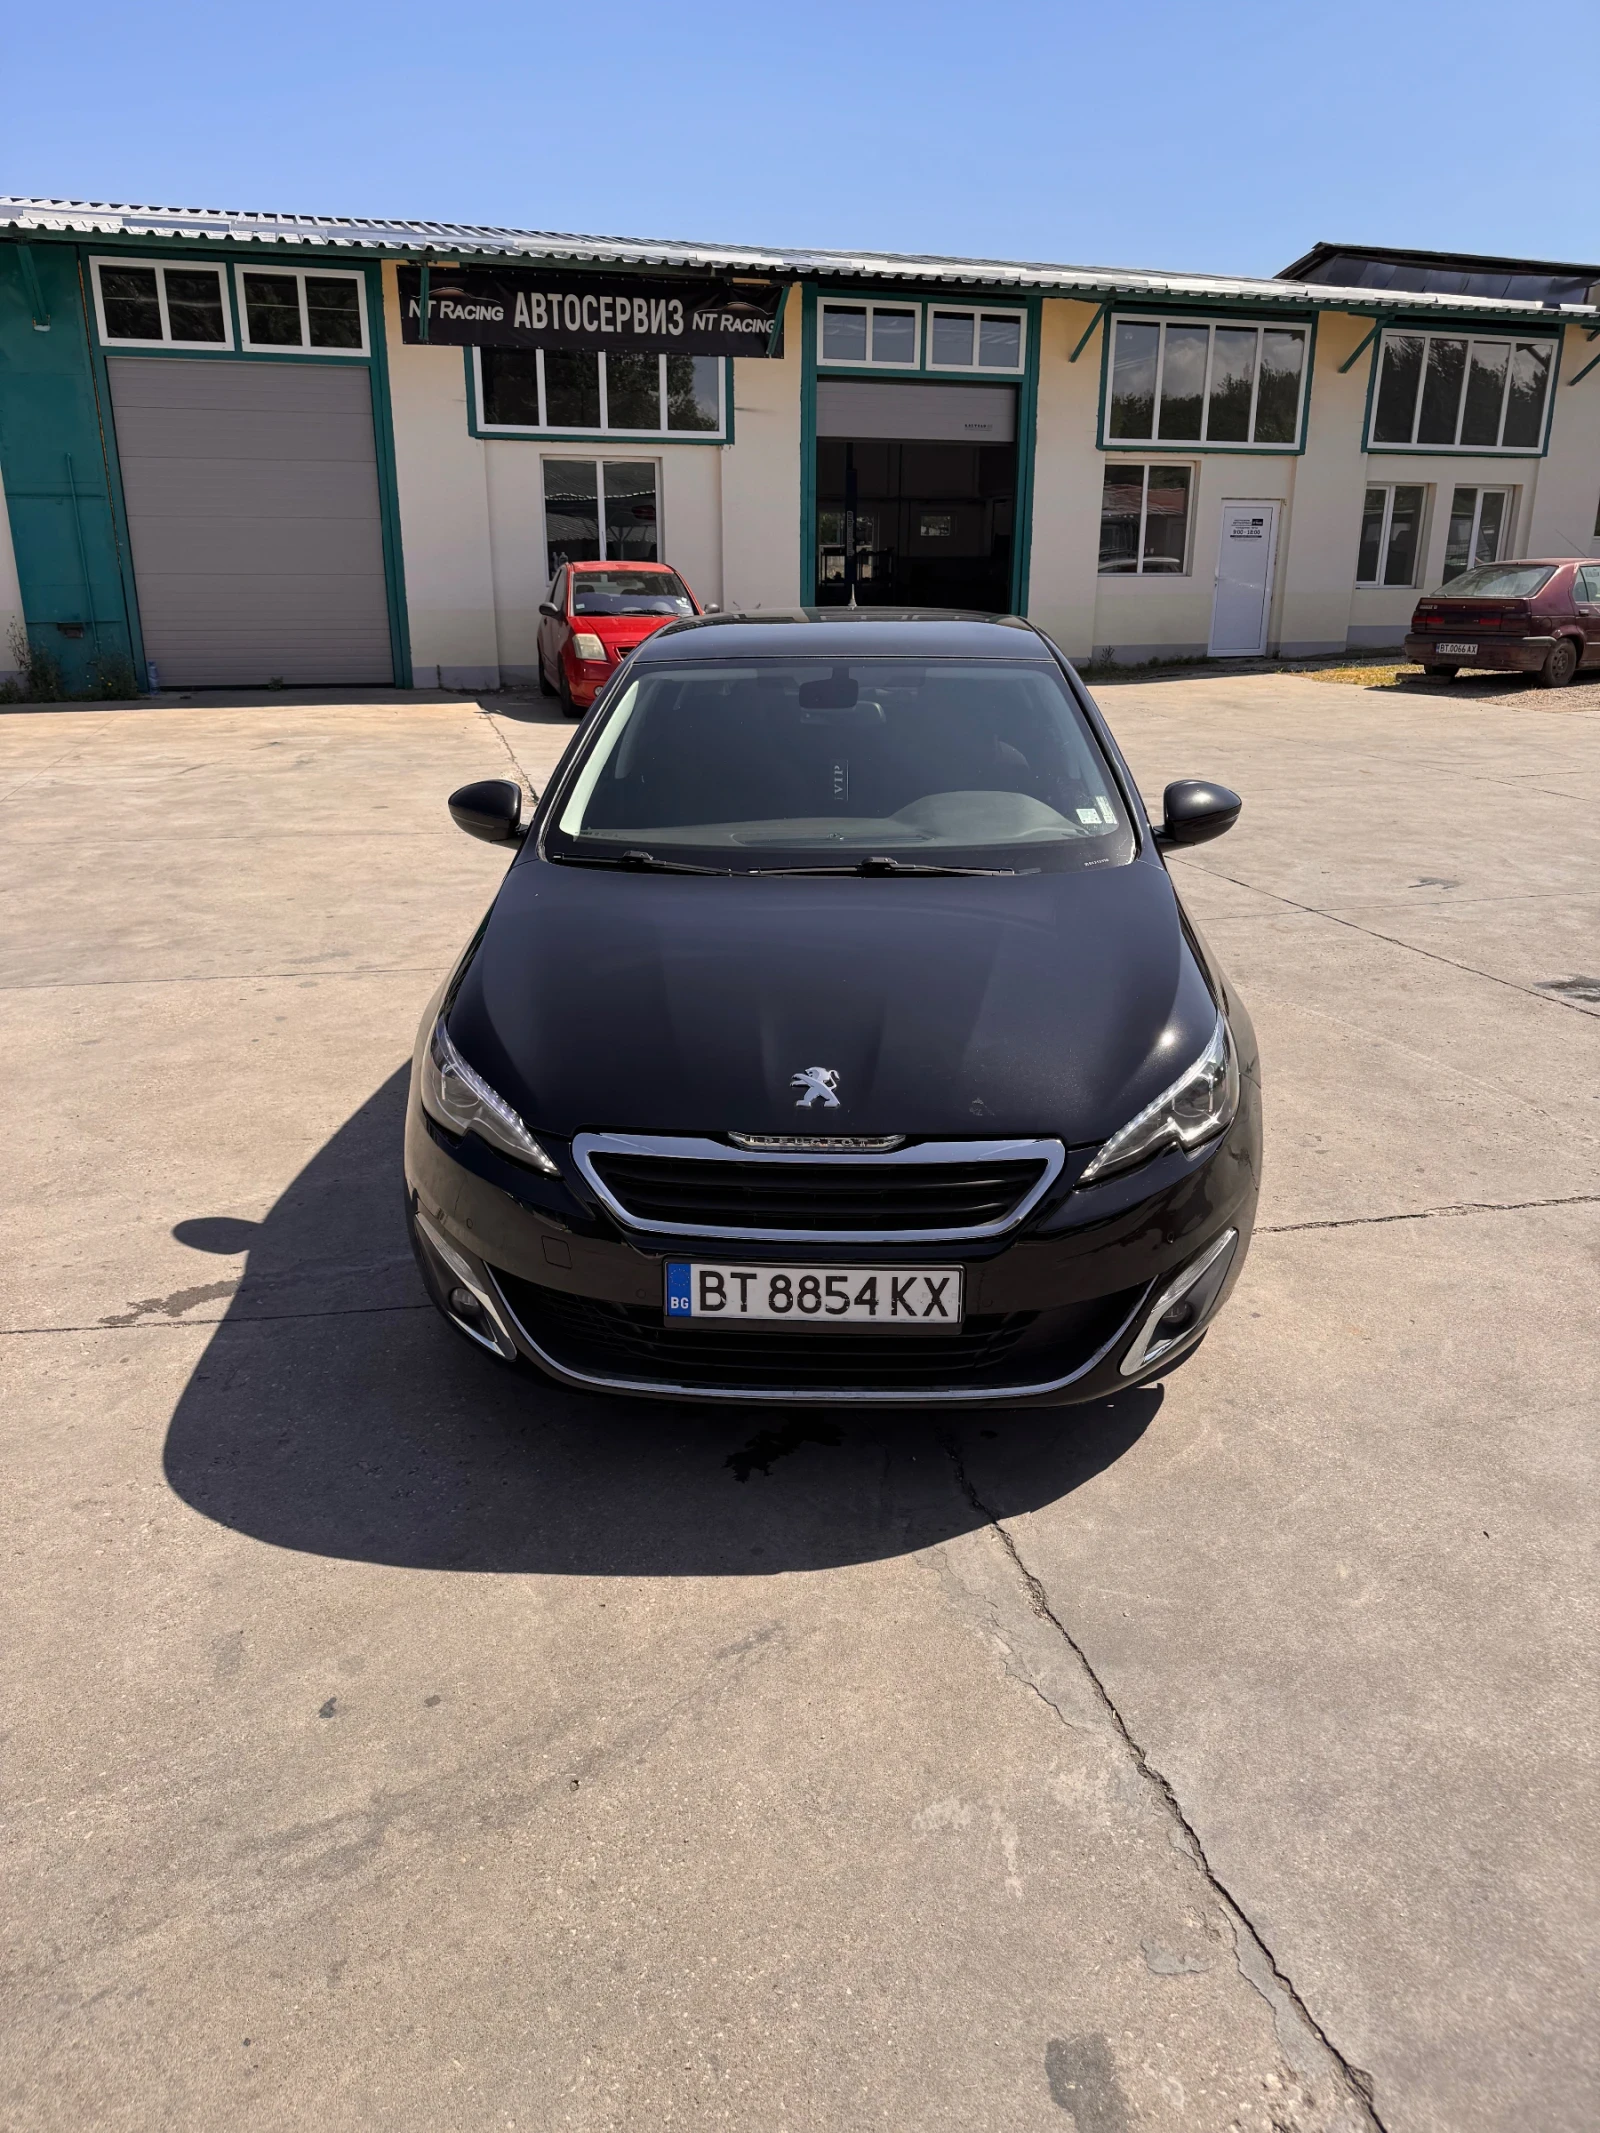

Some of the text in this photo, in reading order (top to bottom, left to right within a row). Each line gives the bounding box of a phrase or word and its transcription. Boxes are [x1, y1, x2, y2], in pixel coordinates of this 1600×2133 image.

[409, 299, 504, 321] NT RACING
[513, 291, 684, 336] АВТОСЕРВИЗ
[692, 313, 718, 331] NT
[834, 765, 843, 794] VIP
[670, 1270, 950, 1317] BG BT 8854 KX
